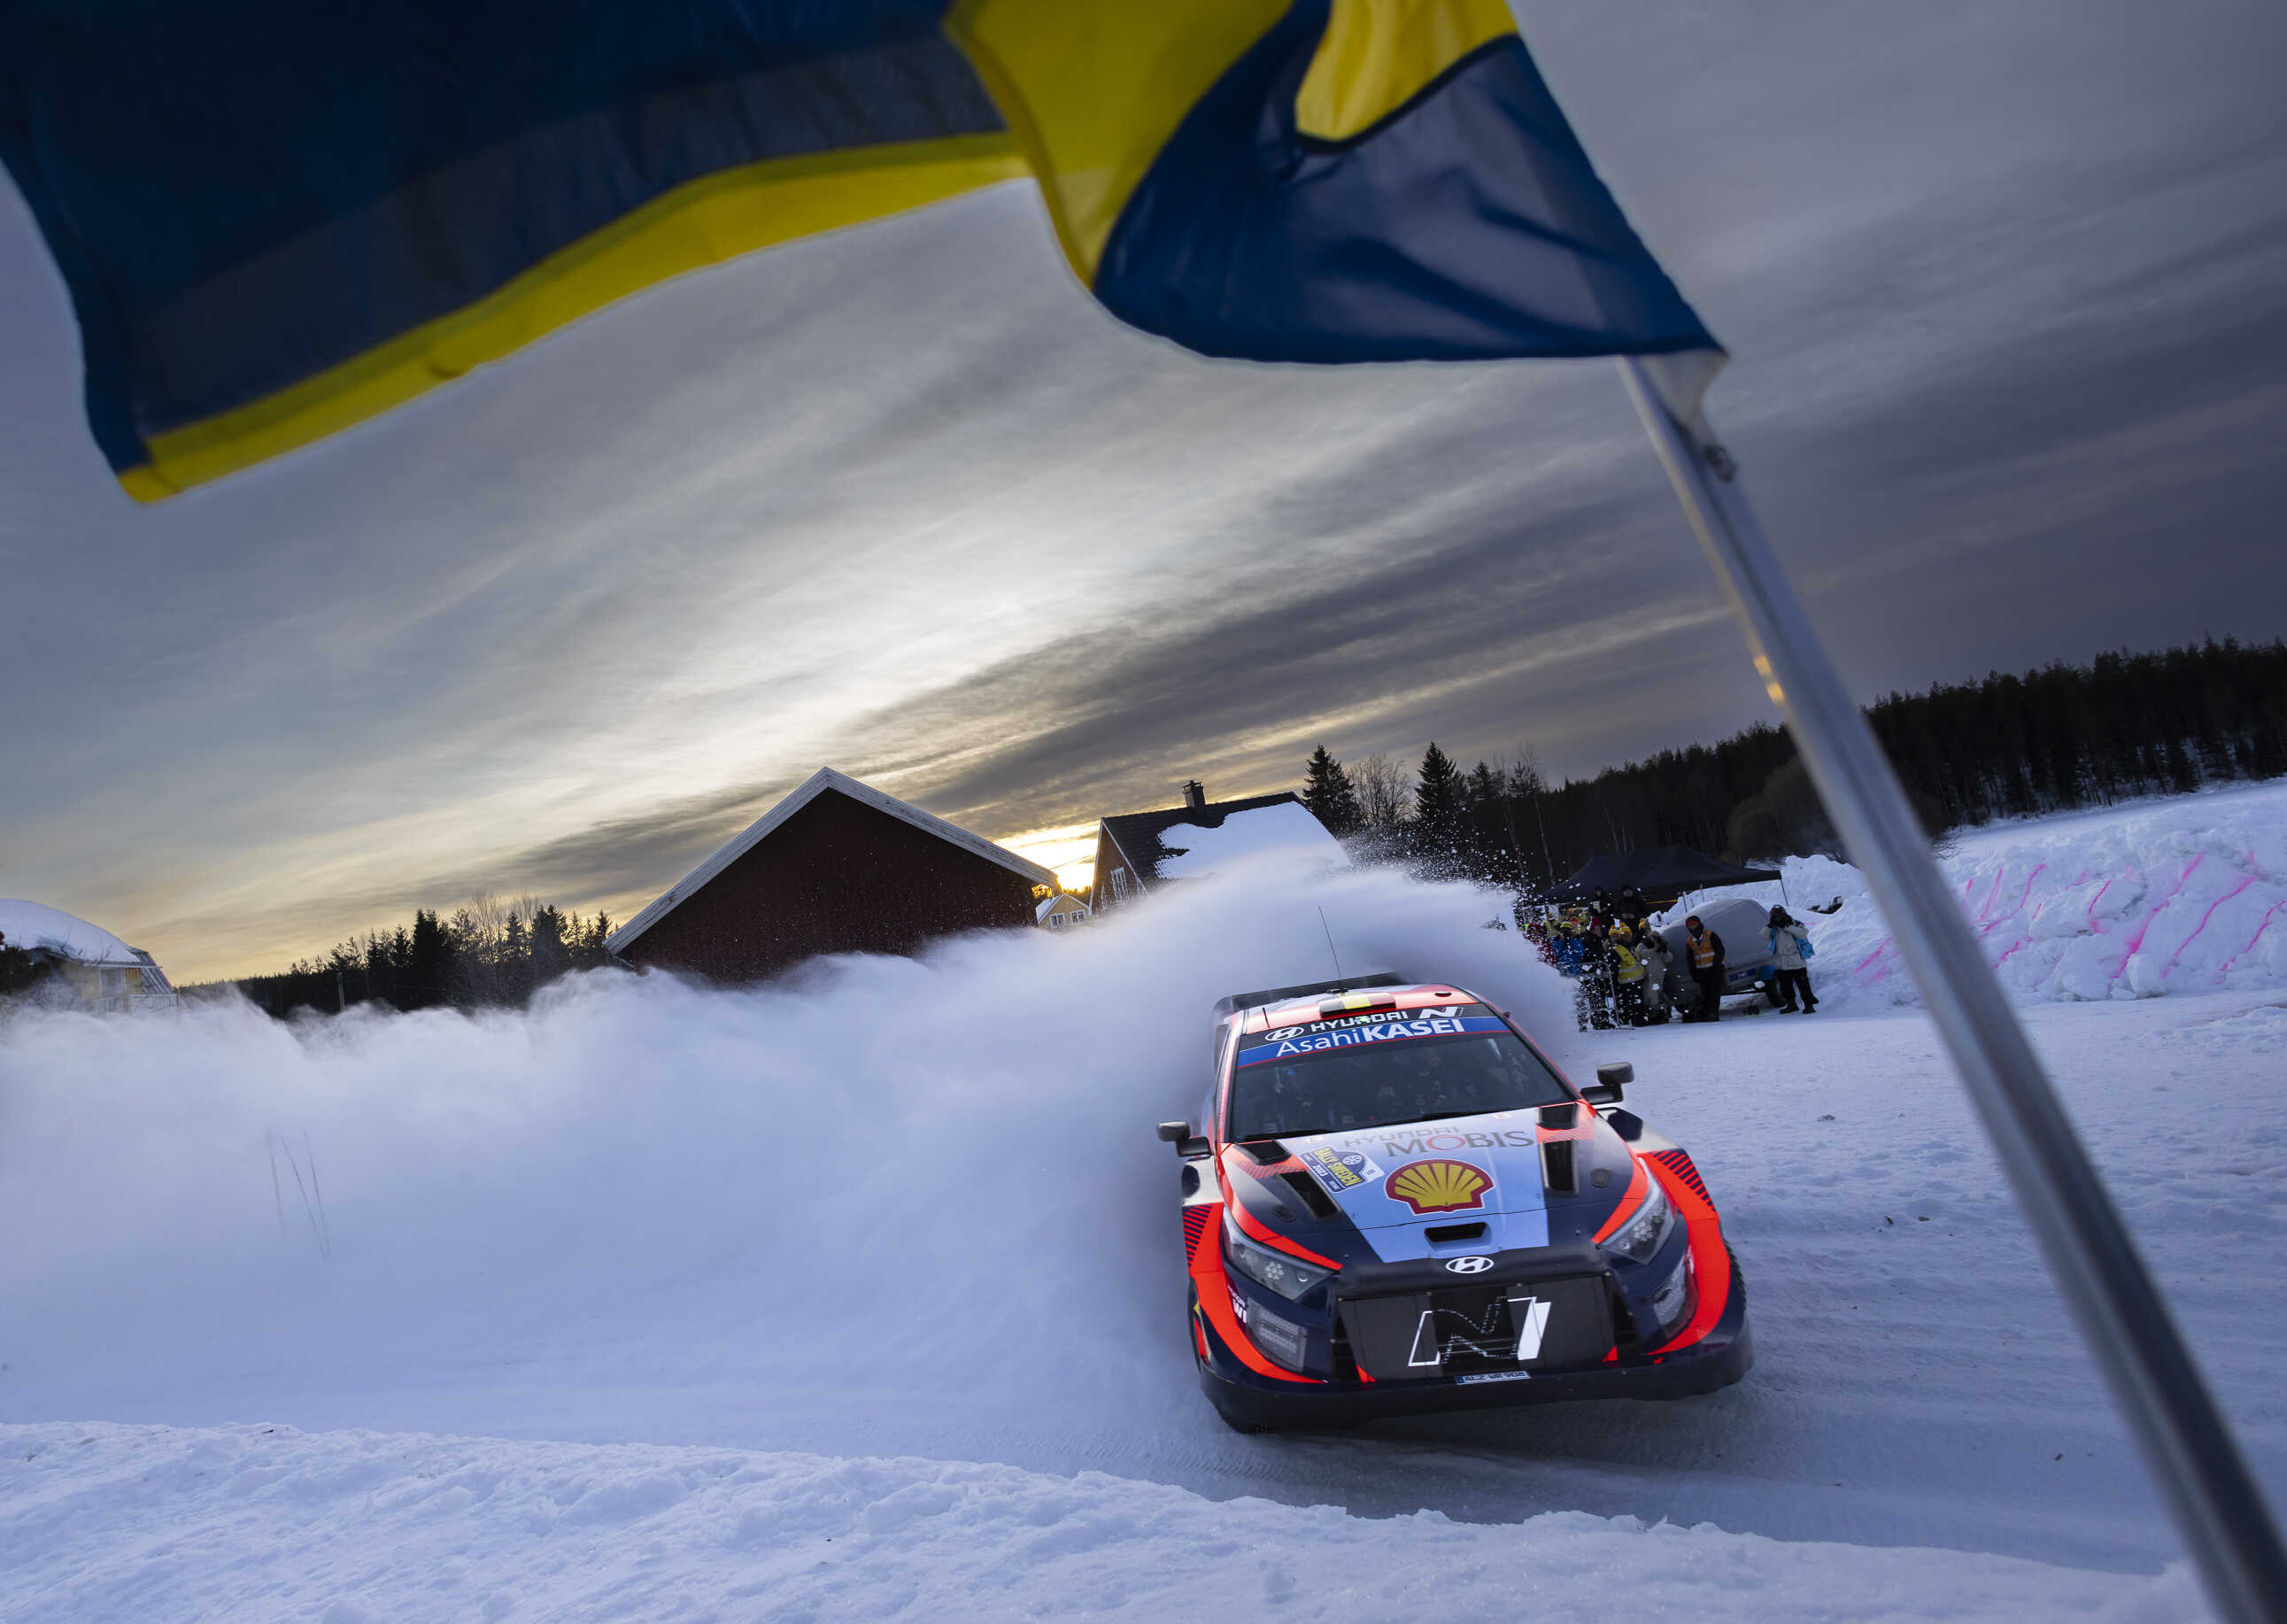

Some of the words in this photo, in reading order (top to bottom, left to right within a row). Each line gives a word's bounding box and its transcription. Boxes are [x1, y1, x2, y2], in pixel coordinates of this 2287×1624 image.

[1310, 1011, 1409, 1032] HYUNDAI
[1344, 1125, 1460, 1148] HYUNDAI
[1384, 1131, 1535, 1157] MOBIS
[1311, 1164, 1328, 1177] 2023
[1327, 1162, 1364, 1187] SWEDEN
